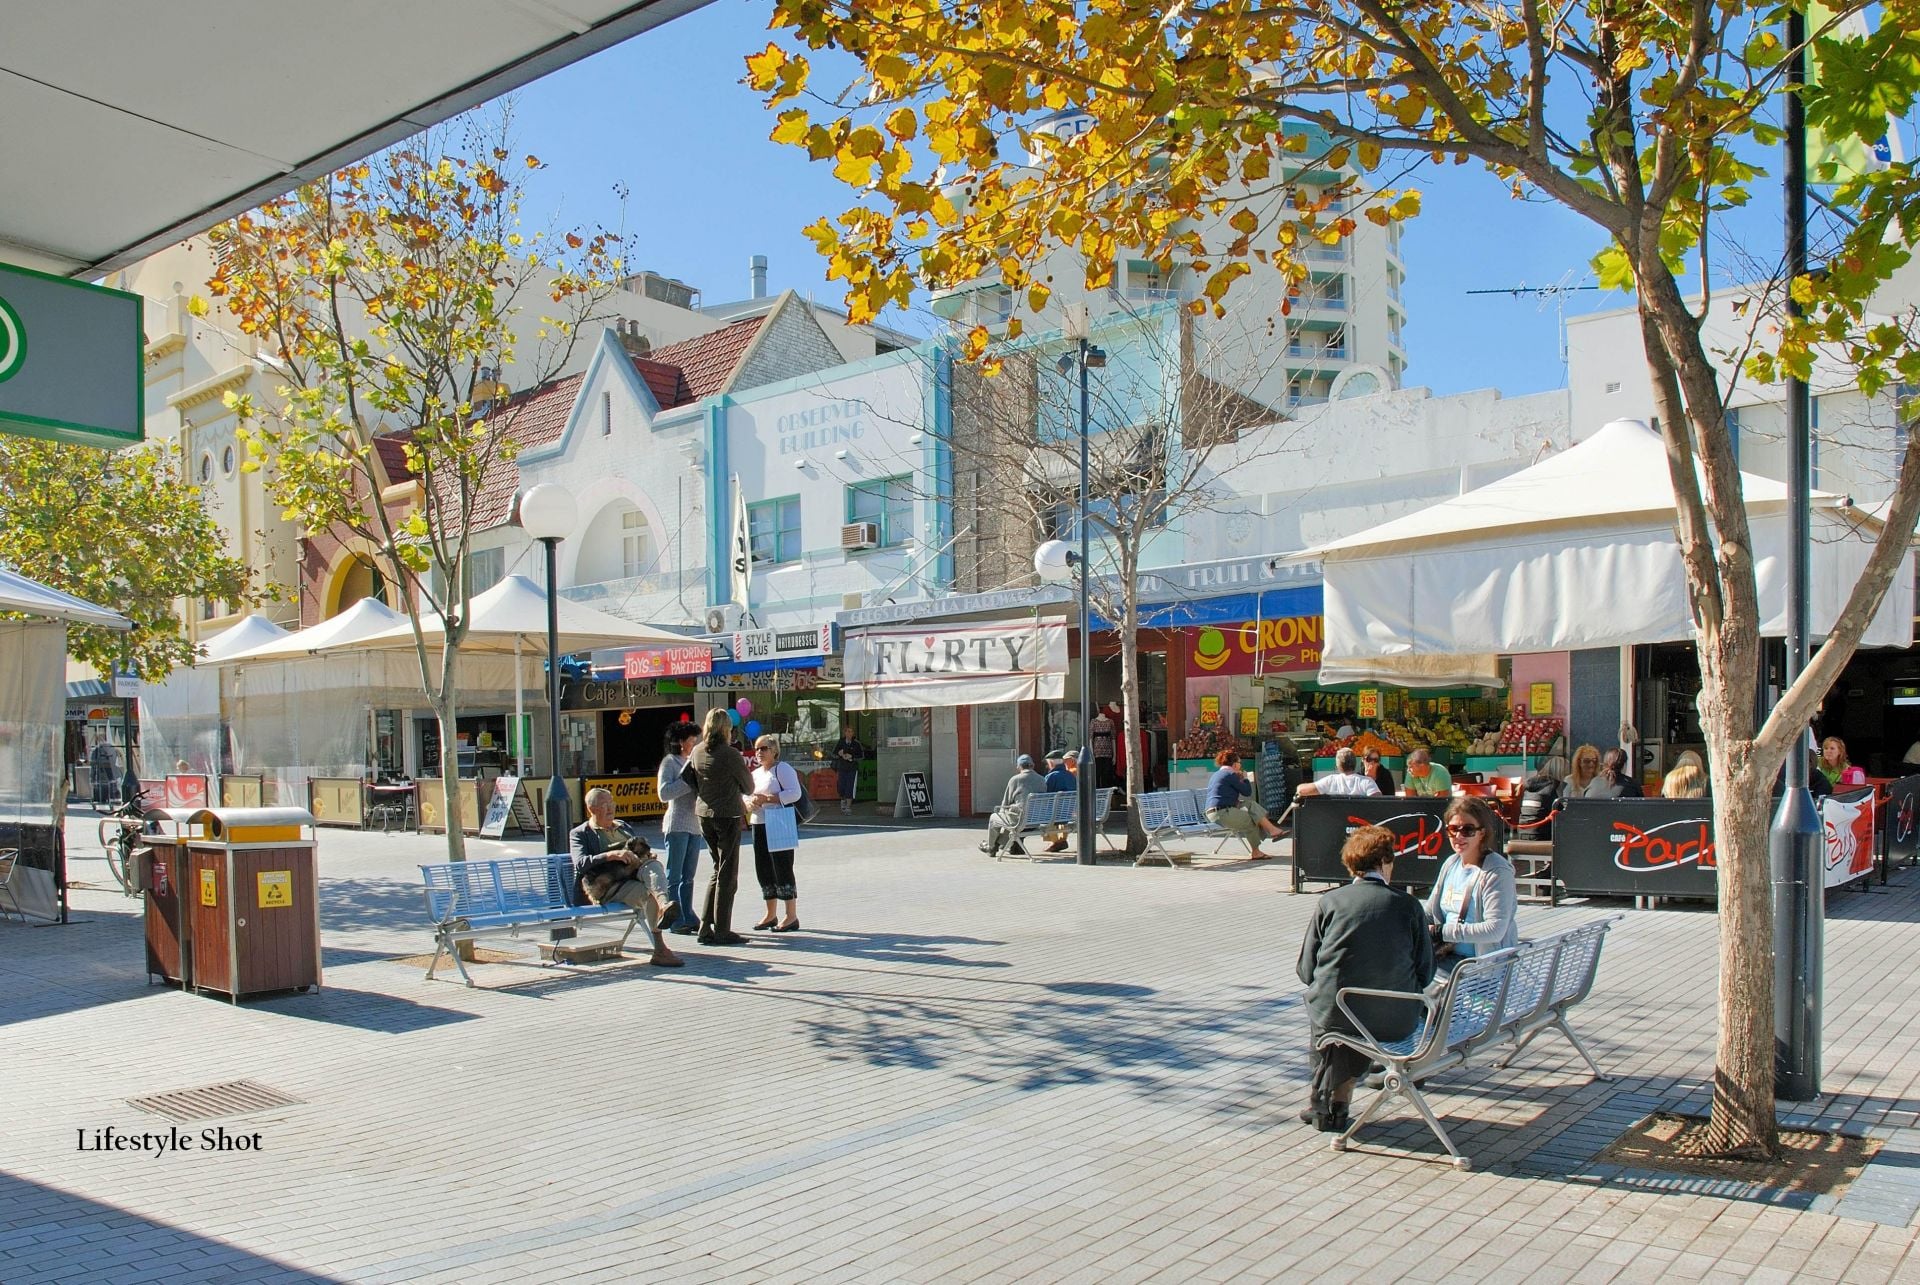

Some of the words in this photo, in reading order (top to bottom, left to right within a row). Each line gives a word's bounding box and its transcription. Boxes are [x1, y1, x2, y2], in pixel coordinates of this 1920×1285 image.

[779, 420, 865, 455] BUILDING
[1188, 563, 1251, 587] FRUIT
[746, 633, 771, 645] STYLE
[777, 633, 818, 649] HAIRDRESSER
[1239, 616, 1324, 654] CRON
[666, 646, 711, 662] TUTORING
[748, 645, 769, 657] PLUS
[625, 657, 650, 676] TOYS
[671, 661, 707, 675] PARTIES
[583, 681, 617, 705] Cafe
[616, 782, 650, 796] COFFEE
[910, 790, 926, 803] $10
[615, 803, 629, 814] ANY
[632, 801, 669, 813] BREAKFAS
